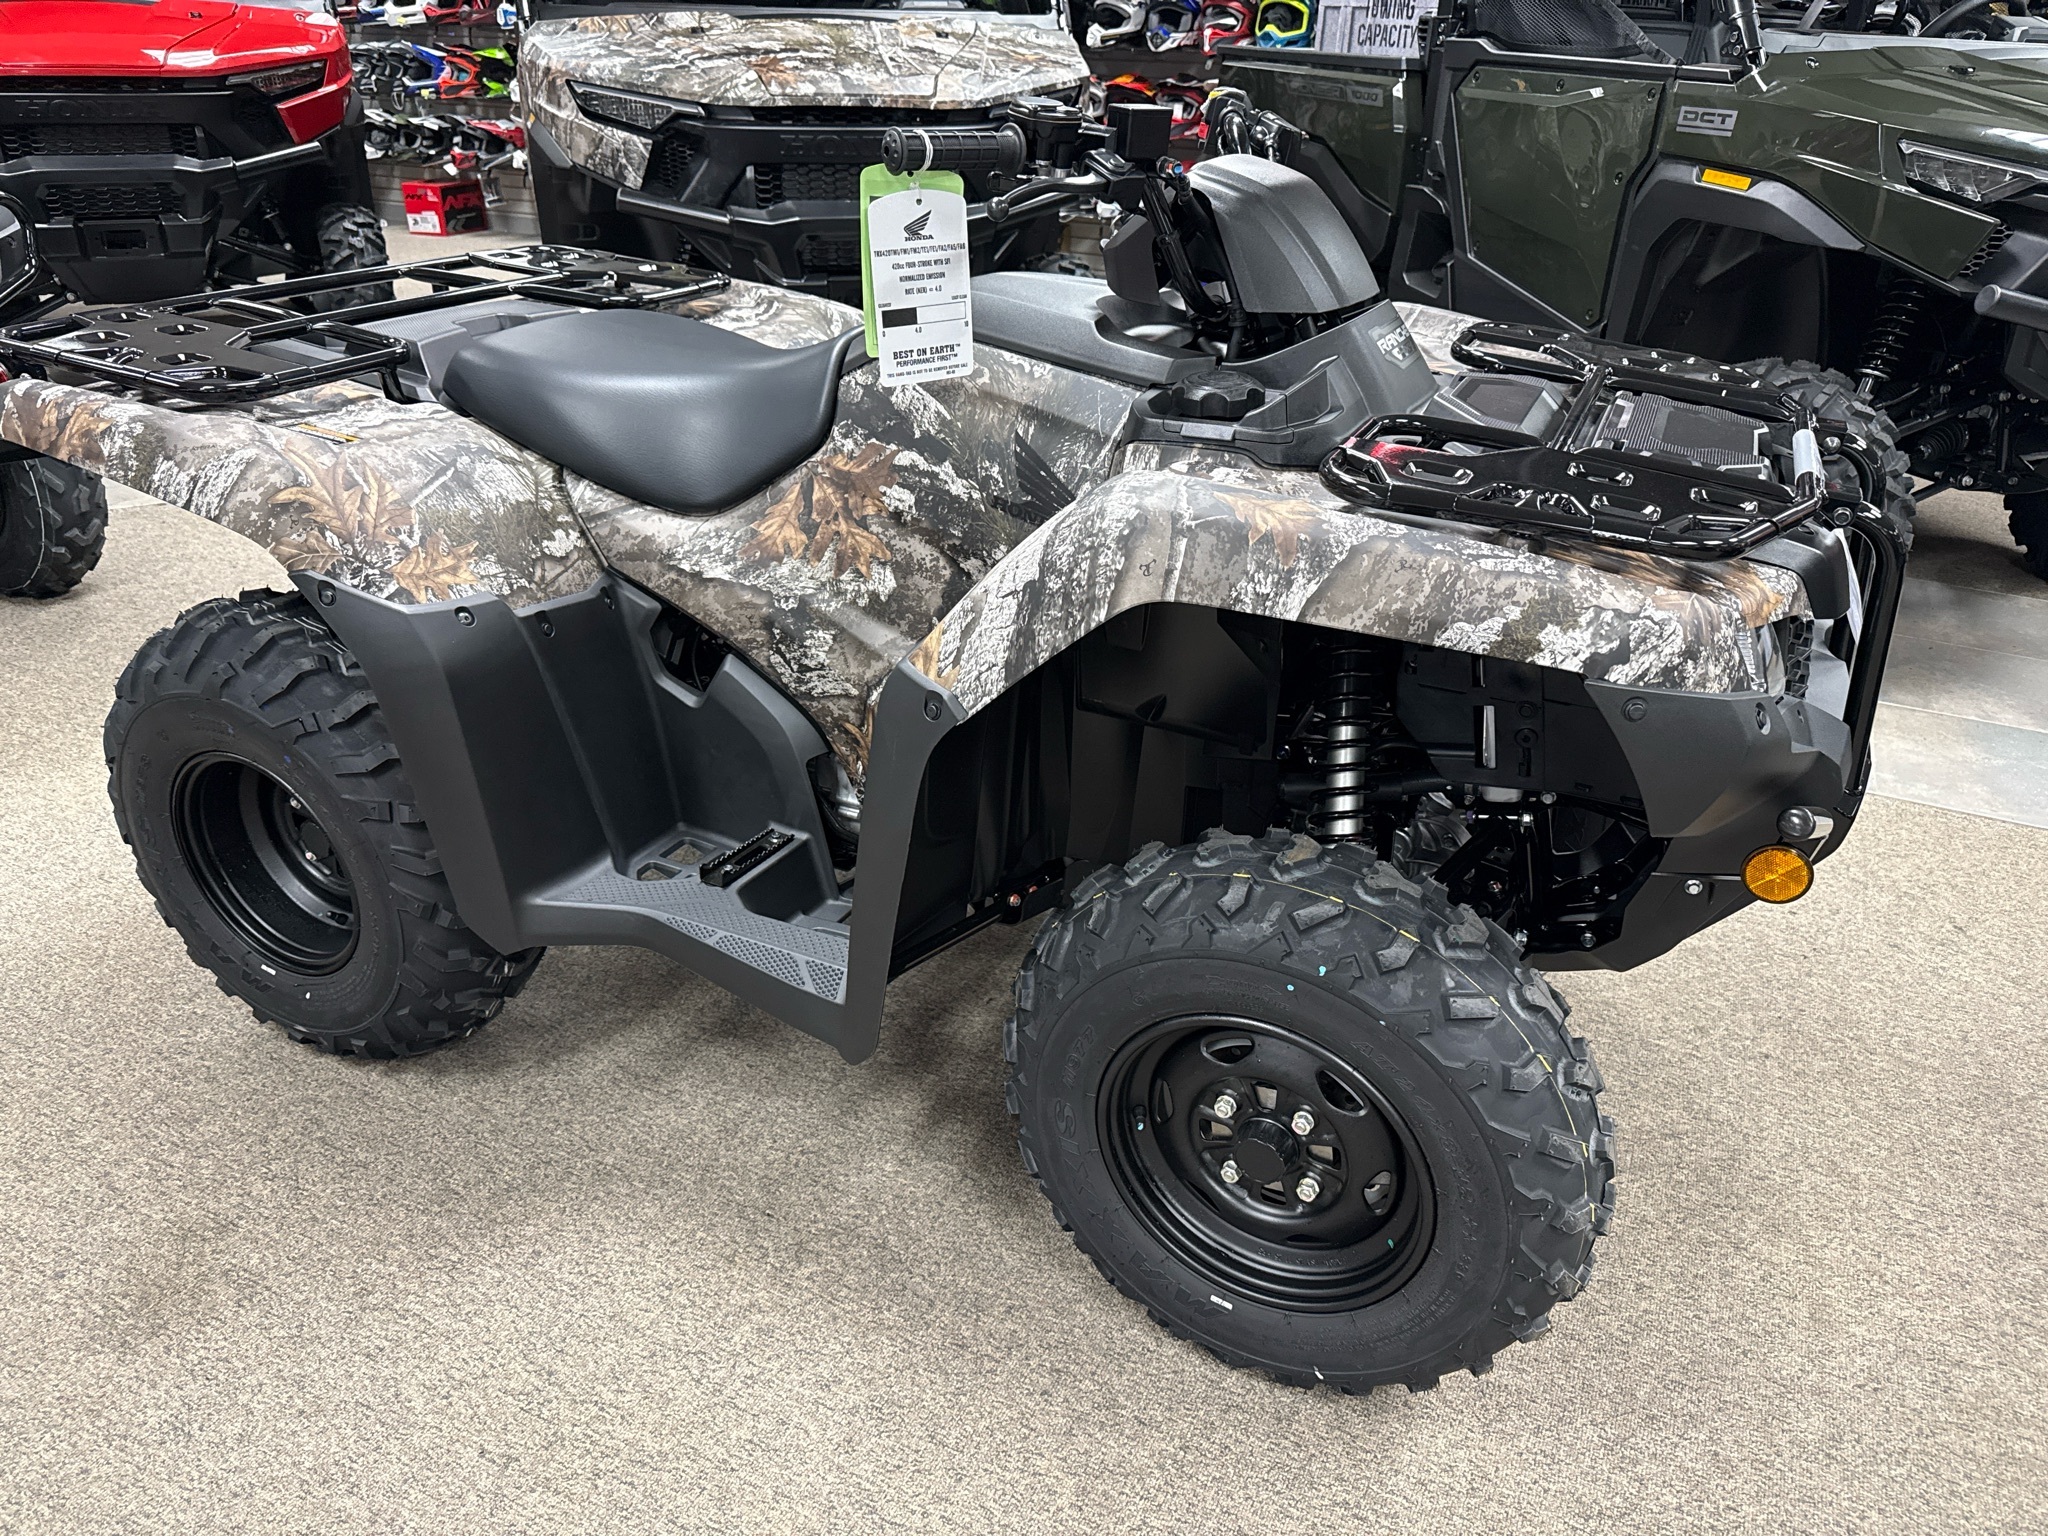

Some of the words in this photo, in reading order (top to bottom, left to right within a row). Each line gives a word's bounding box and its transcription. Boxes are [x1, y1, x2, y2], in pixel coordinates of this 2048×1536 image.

[1357, 23, 1419, 49] CAPACITY
[1682, 110, 1733, 125] DCT
[779, 134, 884, 156] HON
[904, 234, 934, 242] HONDA
[891, 262, 905, 270] 420cc
[905, 259, 933, 269] FOUR-STROKE
[933, 258, 944, 266] WITH
[899, 273, 926, 283] NORMALIZED
[925, 271, 946, 280] EMISSION
[904, 287, 915, 296] RATE
[964, 320, 969, 328] 10
[892, 349, 914, 360] BEST
[916, 347, 928, 357] ON
[896, 356, 936, 368] PERFORMANCE
[1054, 1098, 1230, 1320] MAXXIS
